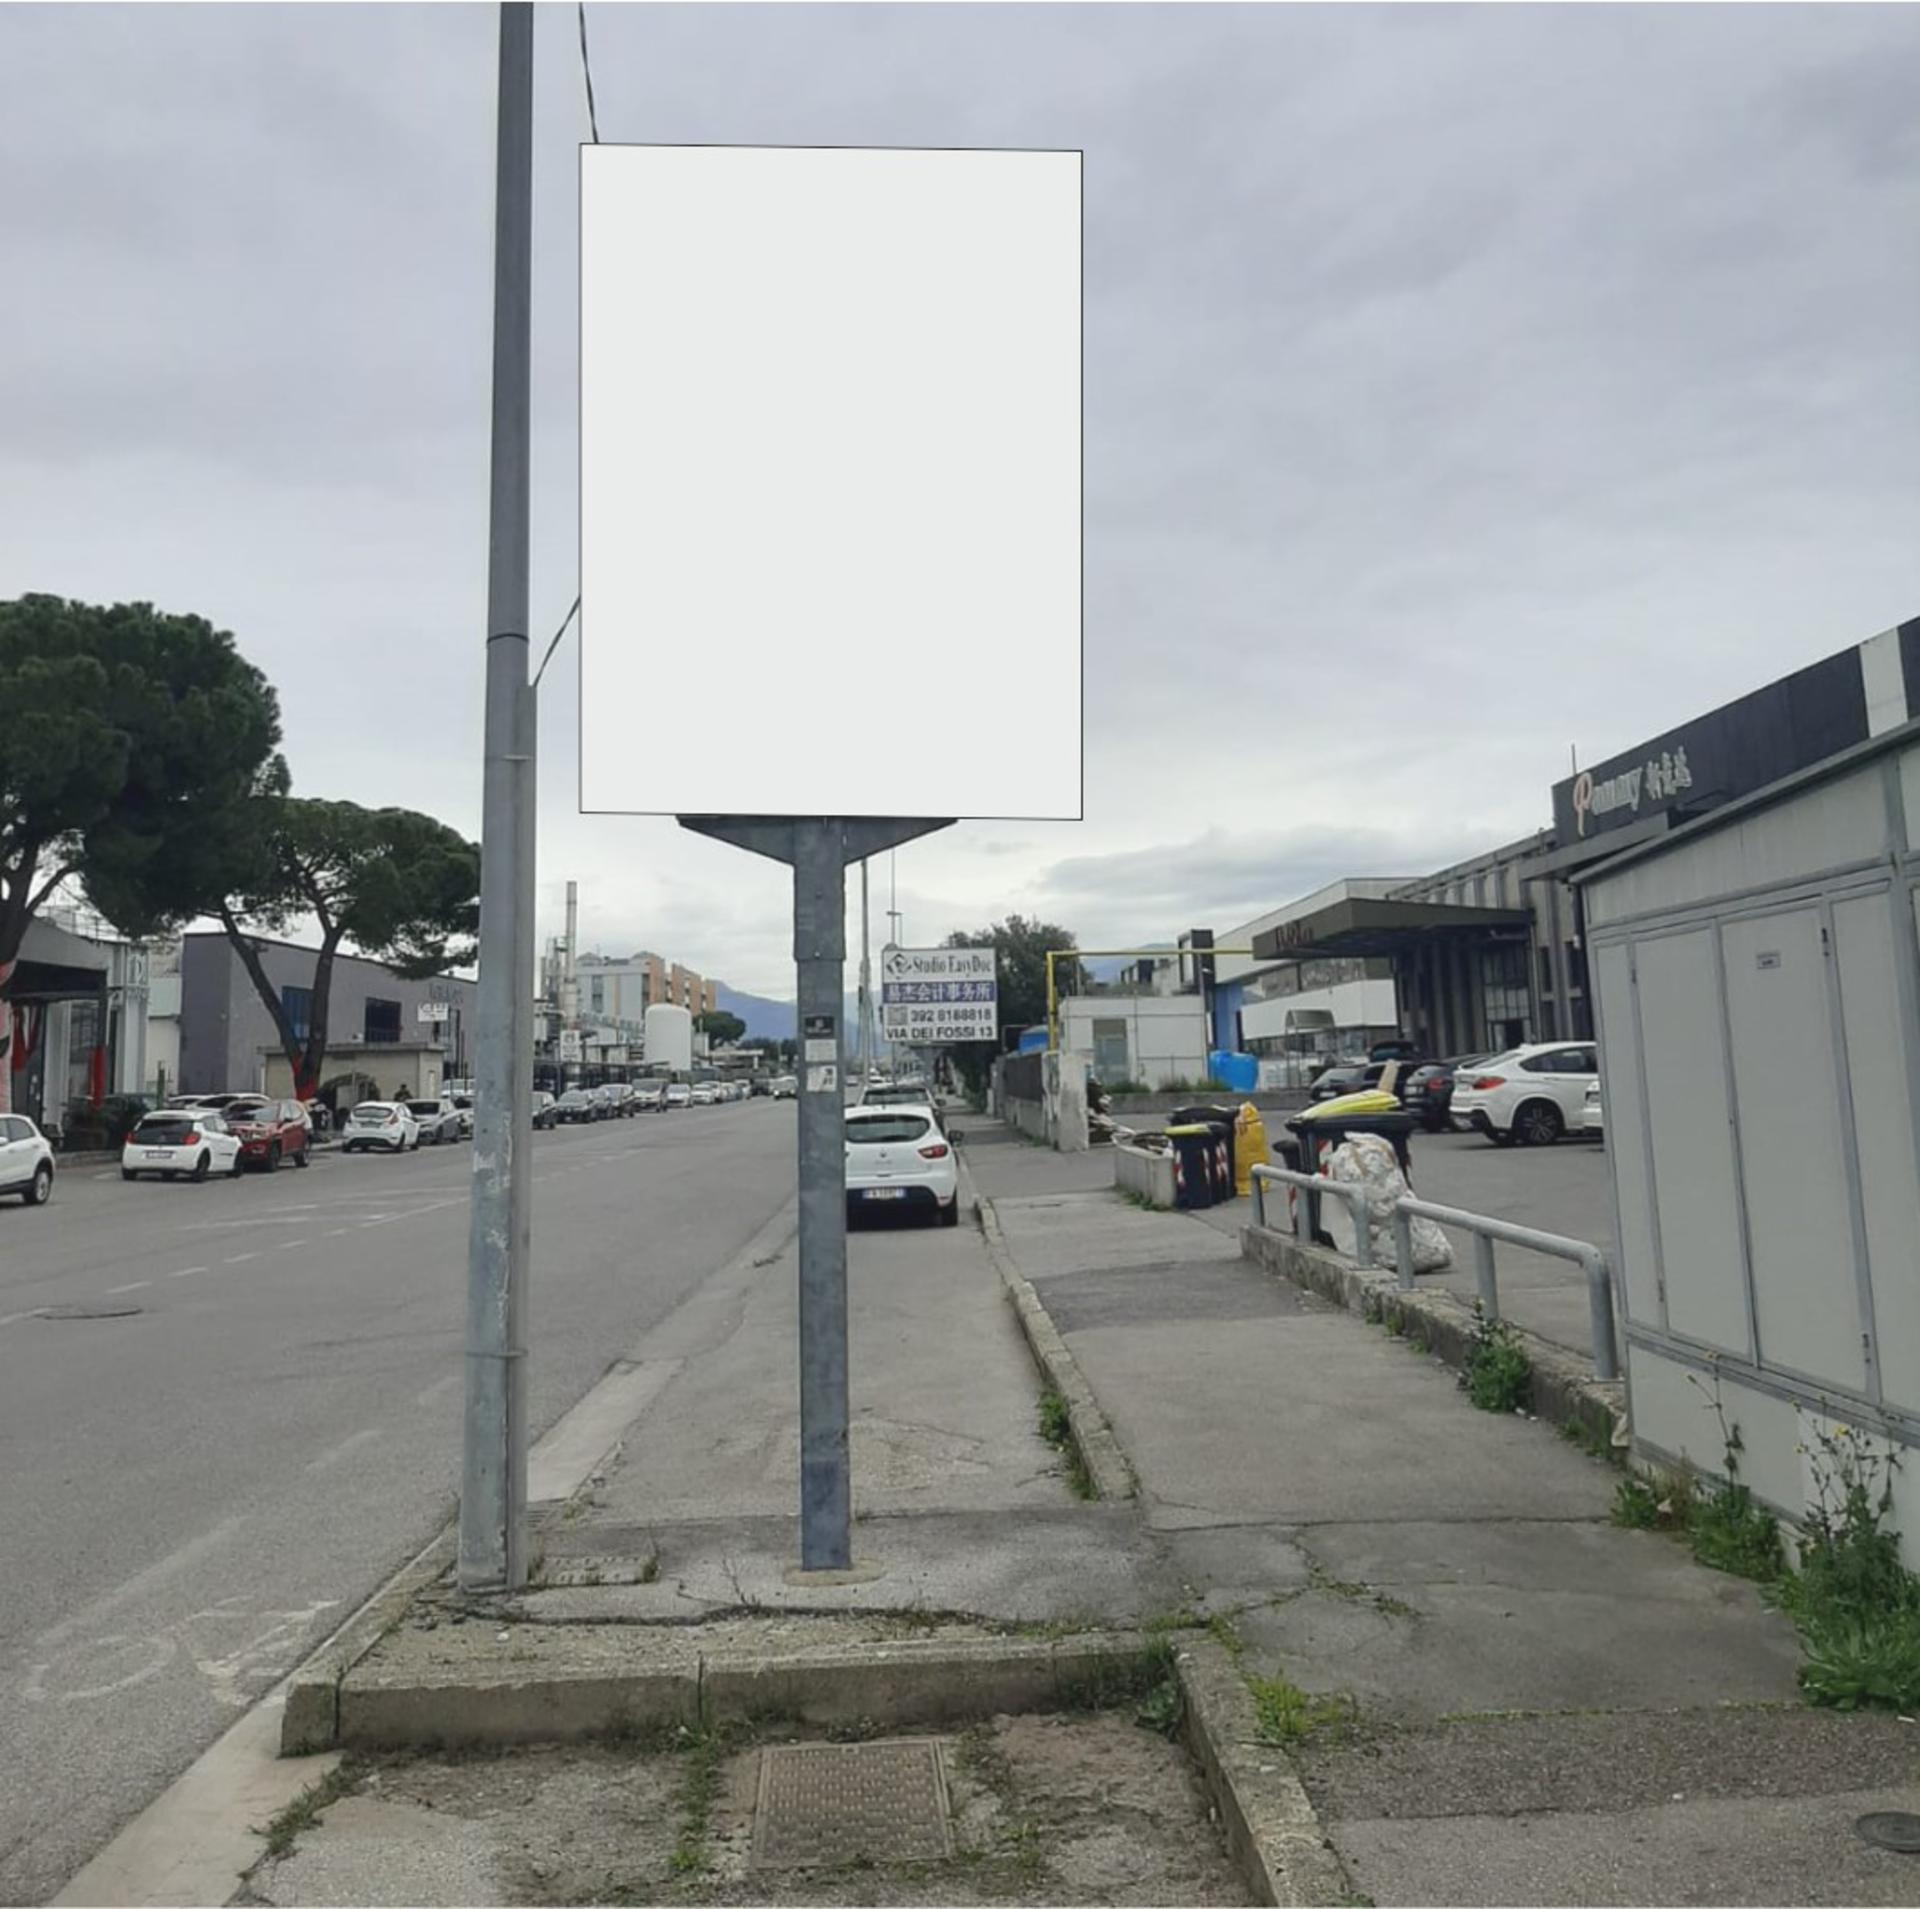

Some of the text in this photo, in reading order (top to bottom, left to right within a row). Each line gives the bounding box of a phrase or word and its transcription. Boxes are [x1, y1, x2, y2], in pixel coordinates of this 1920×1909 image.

[913, 956, 946, 973] Studio
[911, 1009, 934, 1022] 392
[886, 1028, 907, 1039] VIA
[912, 1027, 933, 1038] DEI
[936, 1026, 975, 1038] FOSSI
